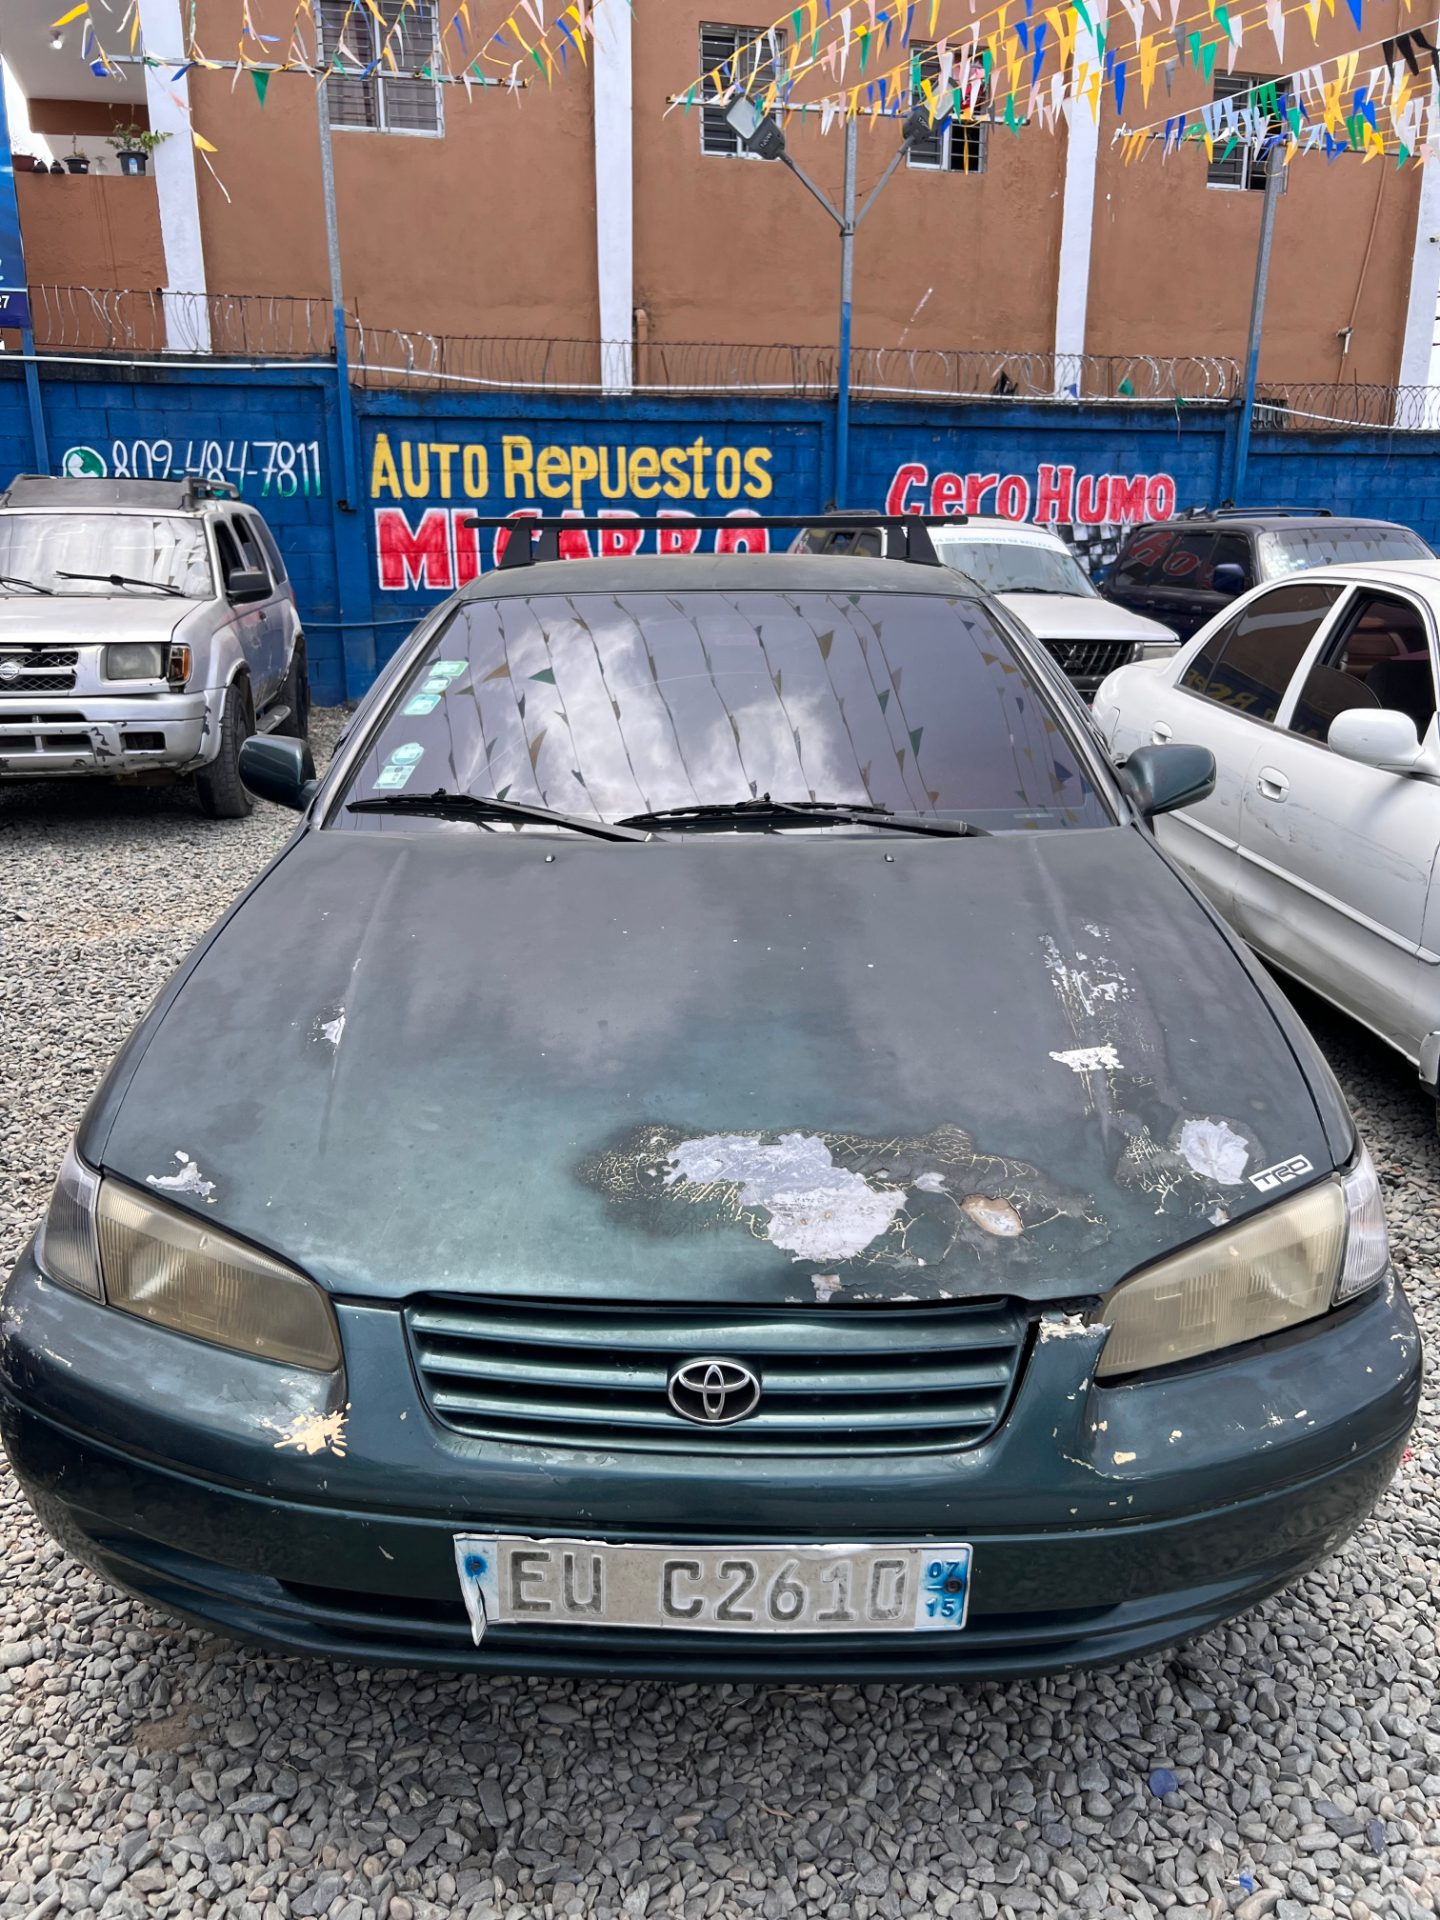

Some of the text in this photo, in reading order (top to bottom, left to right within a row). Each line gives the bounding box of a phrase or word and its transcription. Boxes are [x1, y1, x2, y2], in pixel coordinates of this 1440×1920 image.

[112, 440, 322, 497] 809-484-7811
[501, 434, 774, 509] Repuestos
[373, 507, 482, 592] MI
[1252, 1157, 1310, 1187] TRD
[509, 1550, 908, 1622] EU C2610
[928, 1560, 960, 1579] 07
[925, 1597, 955, 1618] 15
